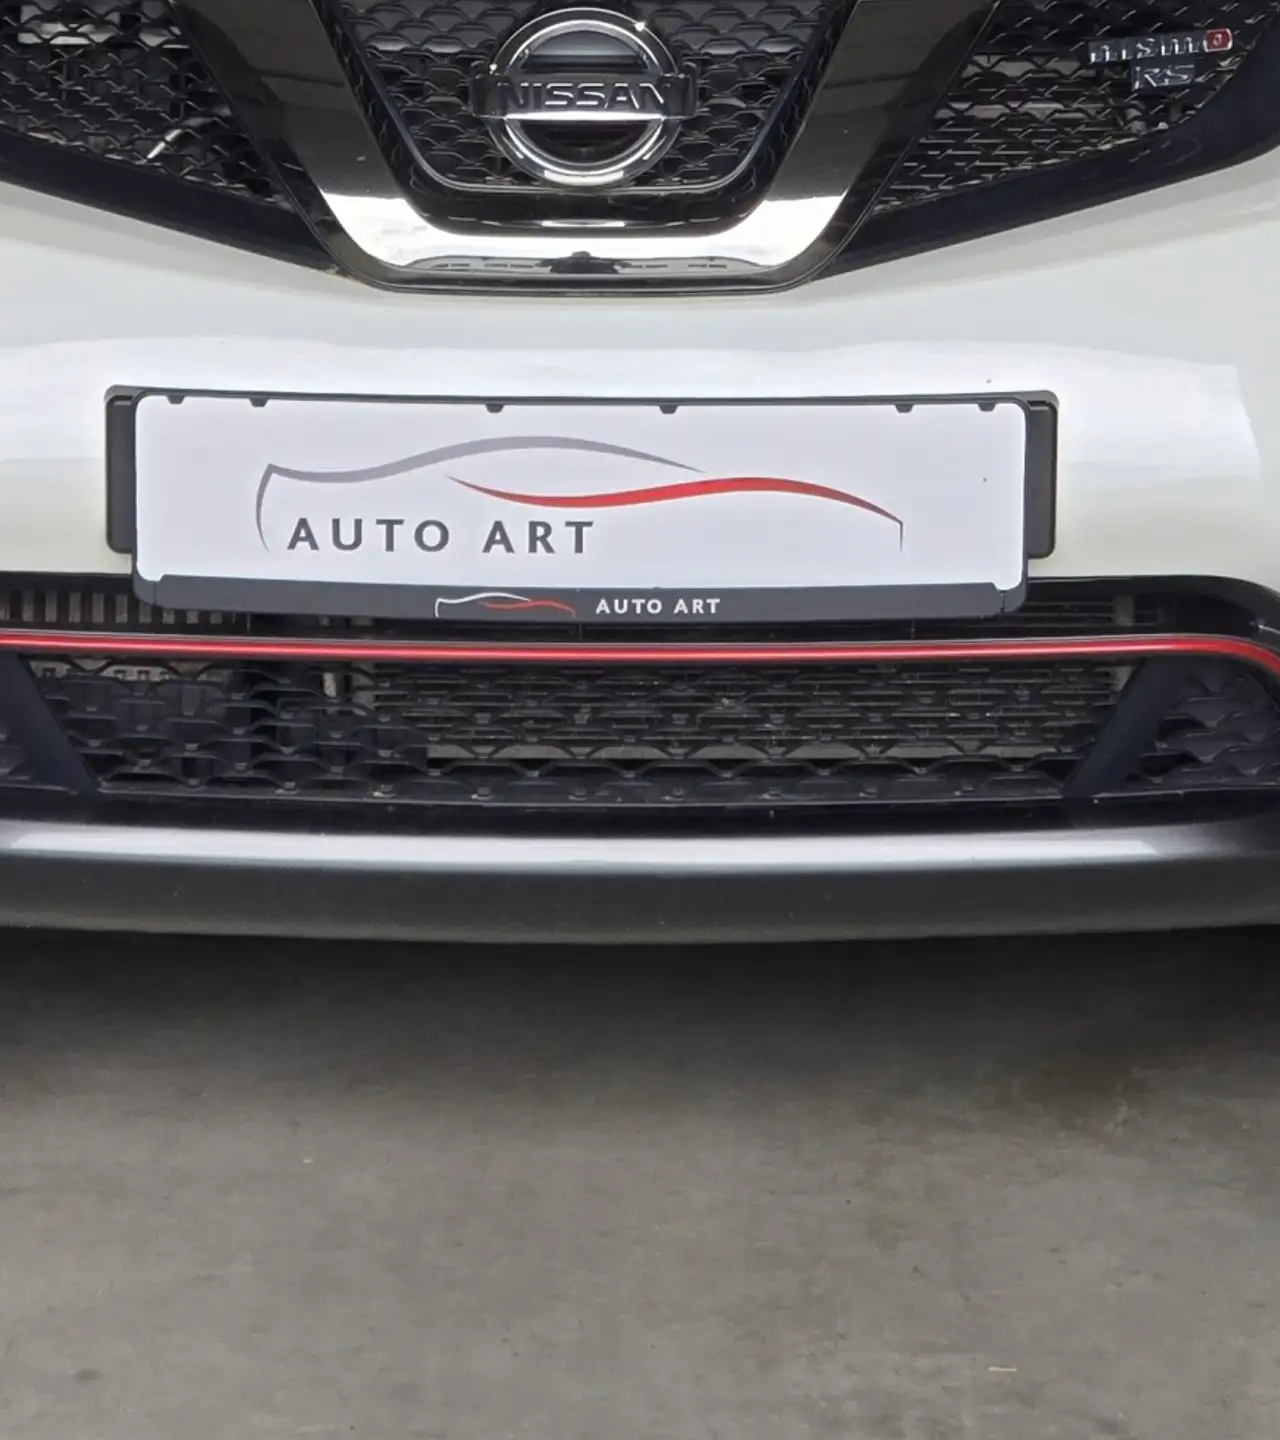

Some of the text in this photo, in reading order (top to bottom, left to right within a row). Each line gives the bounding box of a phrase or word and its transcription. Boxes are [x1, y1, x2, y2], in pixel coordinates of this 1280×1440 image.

[496, 82, 670, 110] NISSAN
[286, 517, 594, 554] AUTO ART
[595, 597, 721, 615] AUTO ART
